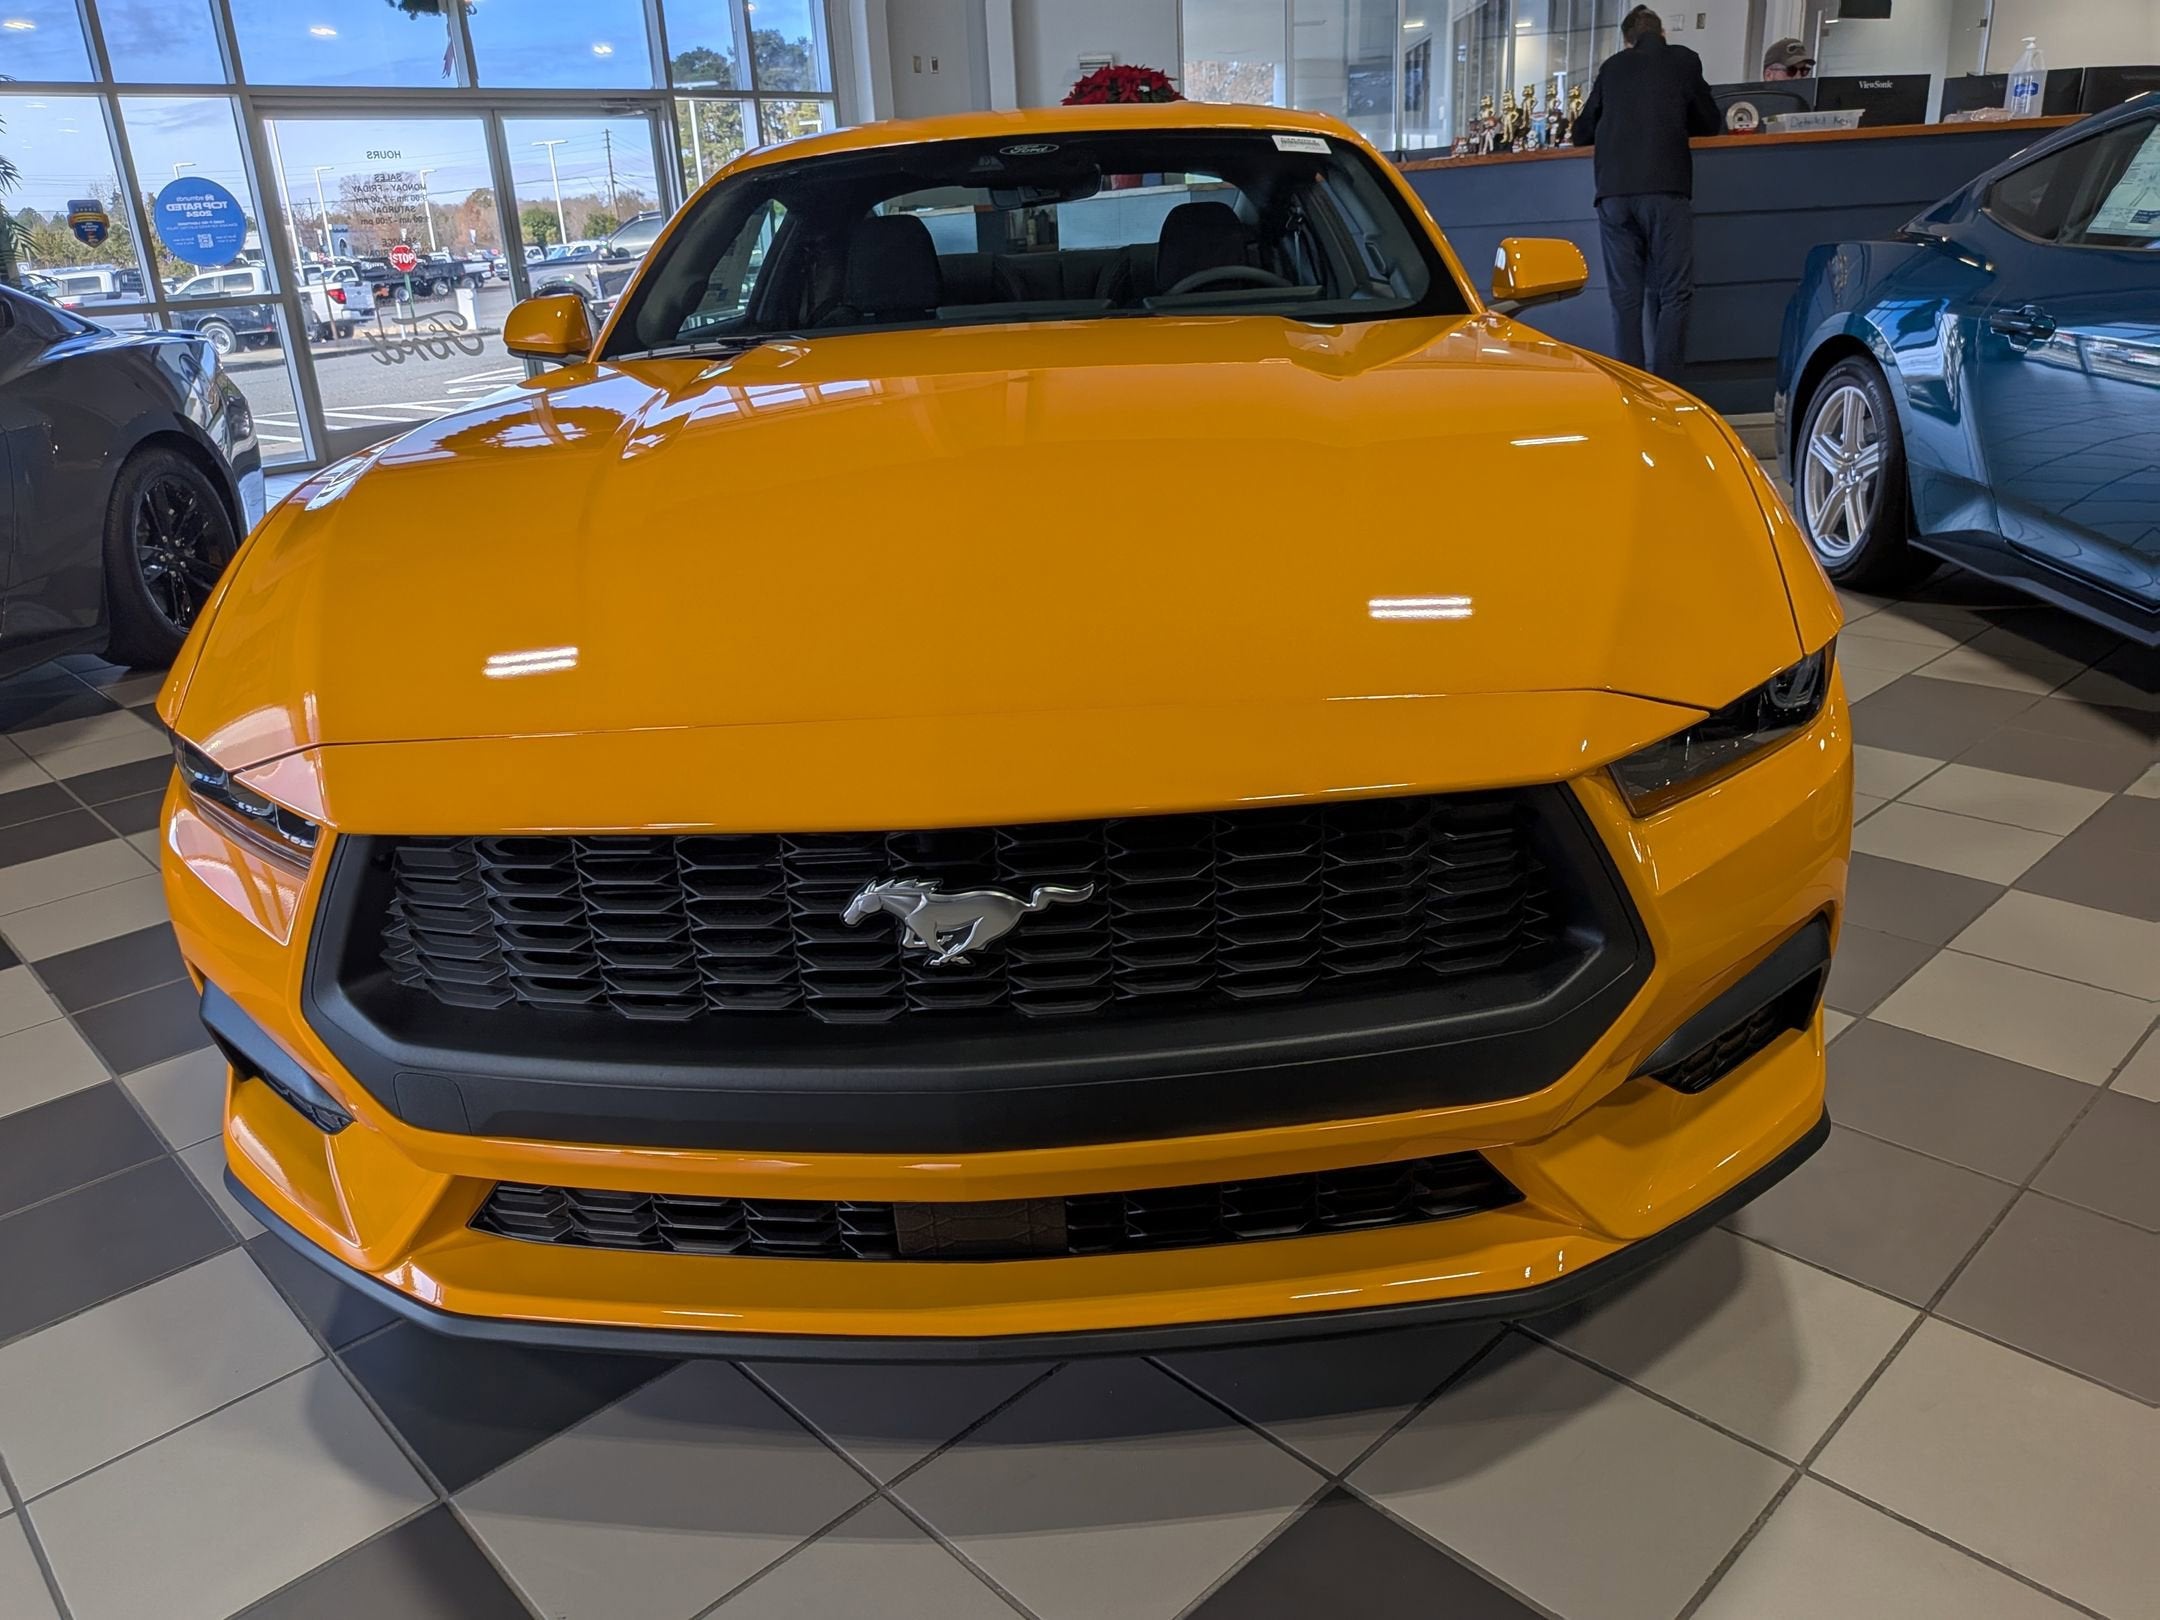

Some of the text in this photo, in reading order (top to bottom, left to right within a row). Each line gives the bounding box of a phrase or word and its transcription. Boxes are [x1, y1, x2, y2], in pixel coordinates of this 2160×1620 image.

[1858, 80, 1893, 88] ViewSonic
[1009, 144, 1049, 154] Ford
[392, 252, 414, 264] STOP
